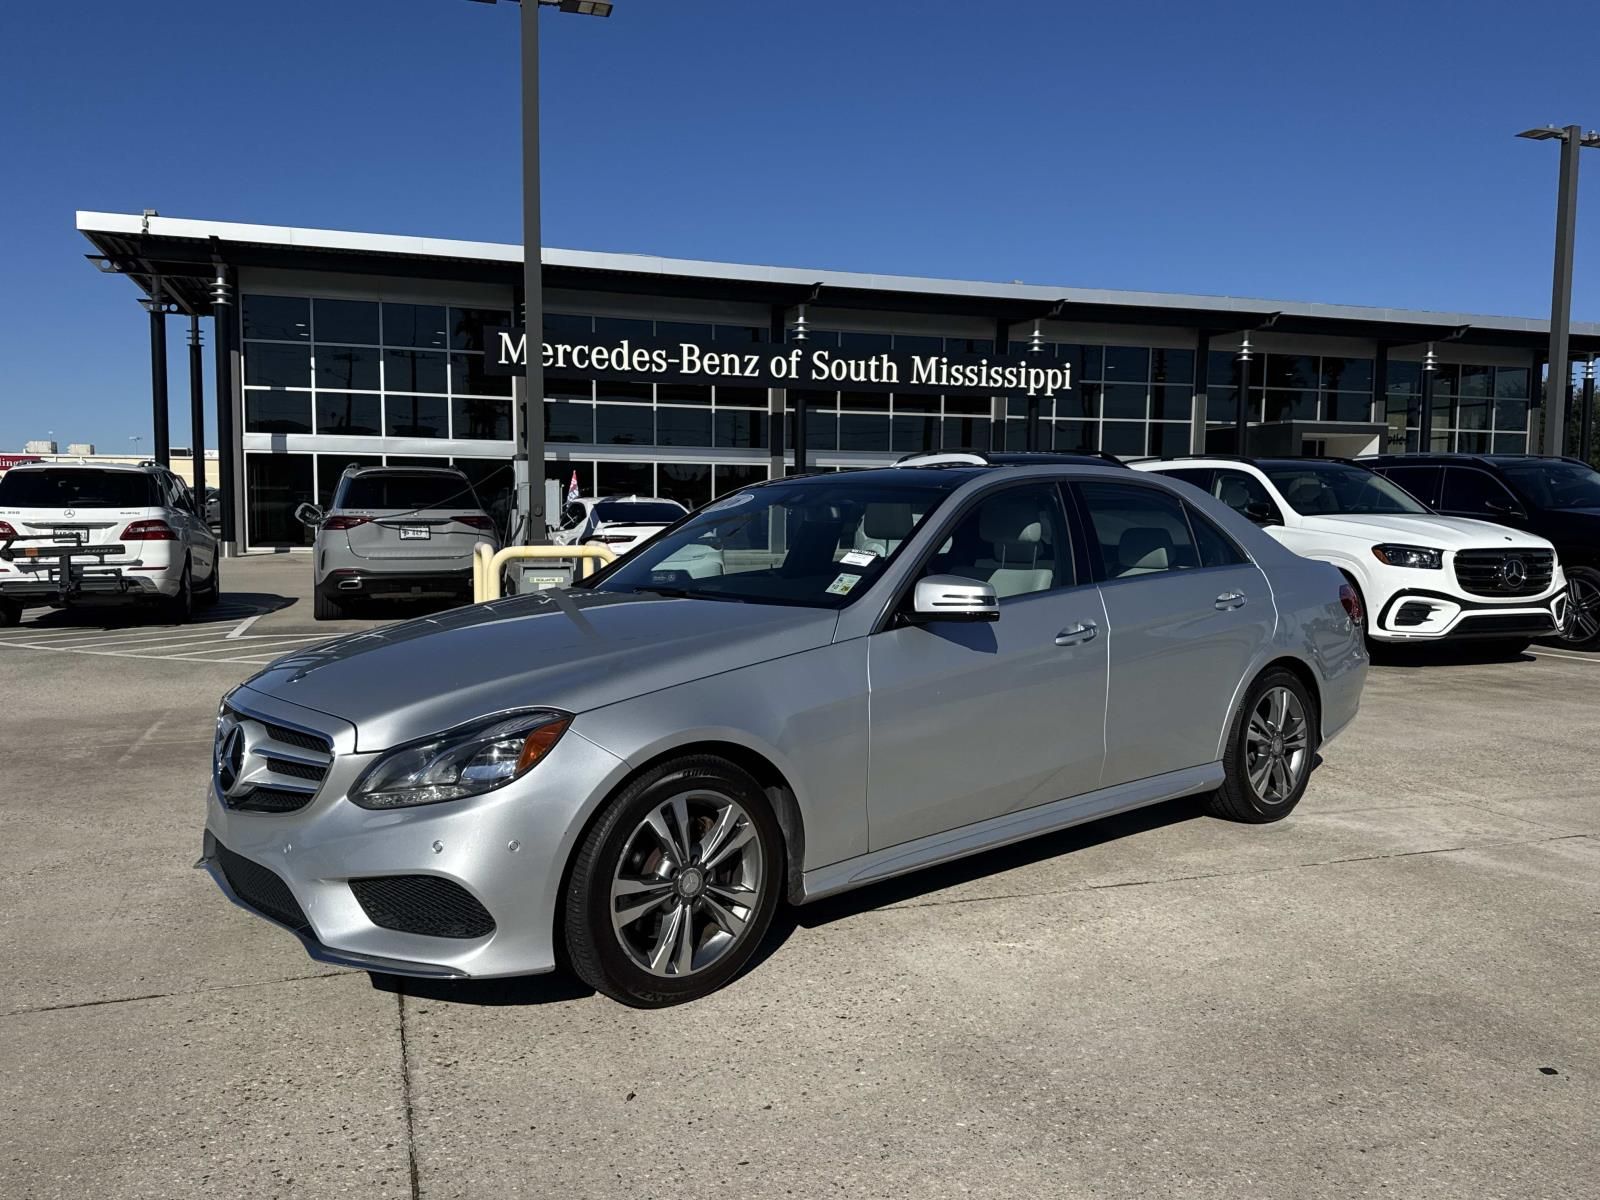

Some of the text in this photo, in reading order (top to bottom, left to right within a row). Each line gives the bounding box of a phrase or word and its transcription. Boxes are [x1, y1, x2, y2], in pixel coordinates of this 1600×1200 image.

[498, 332, 1073, 397] Mercedes-Benz of South Mississippi
